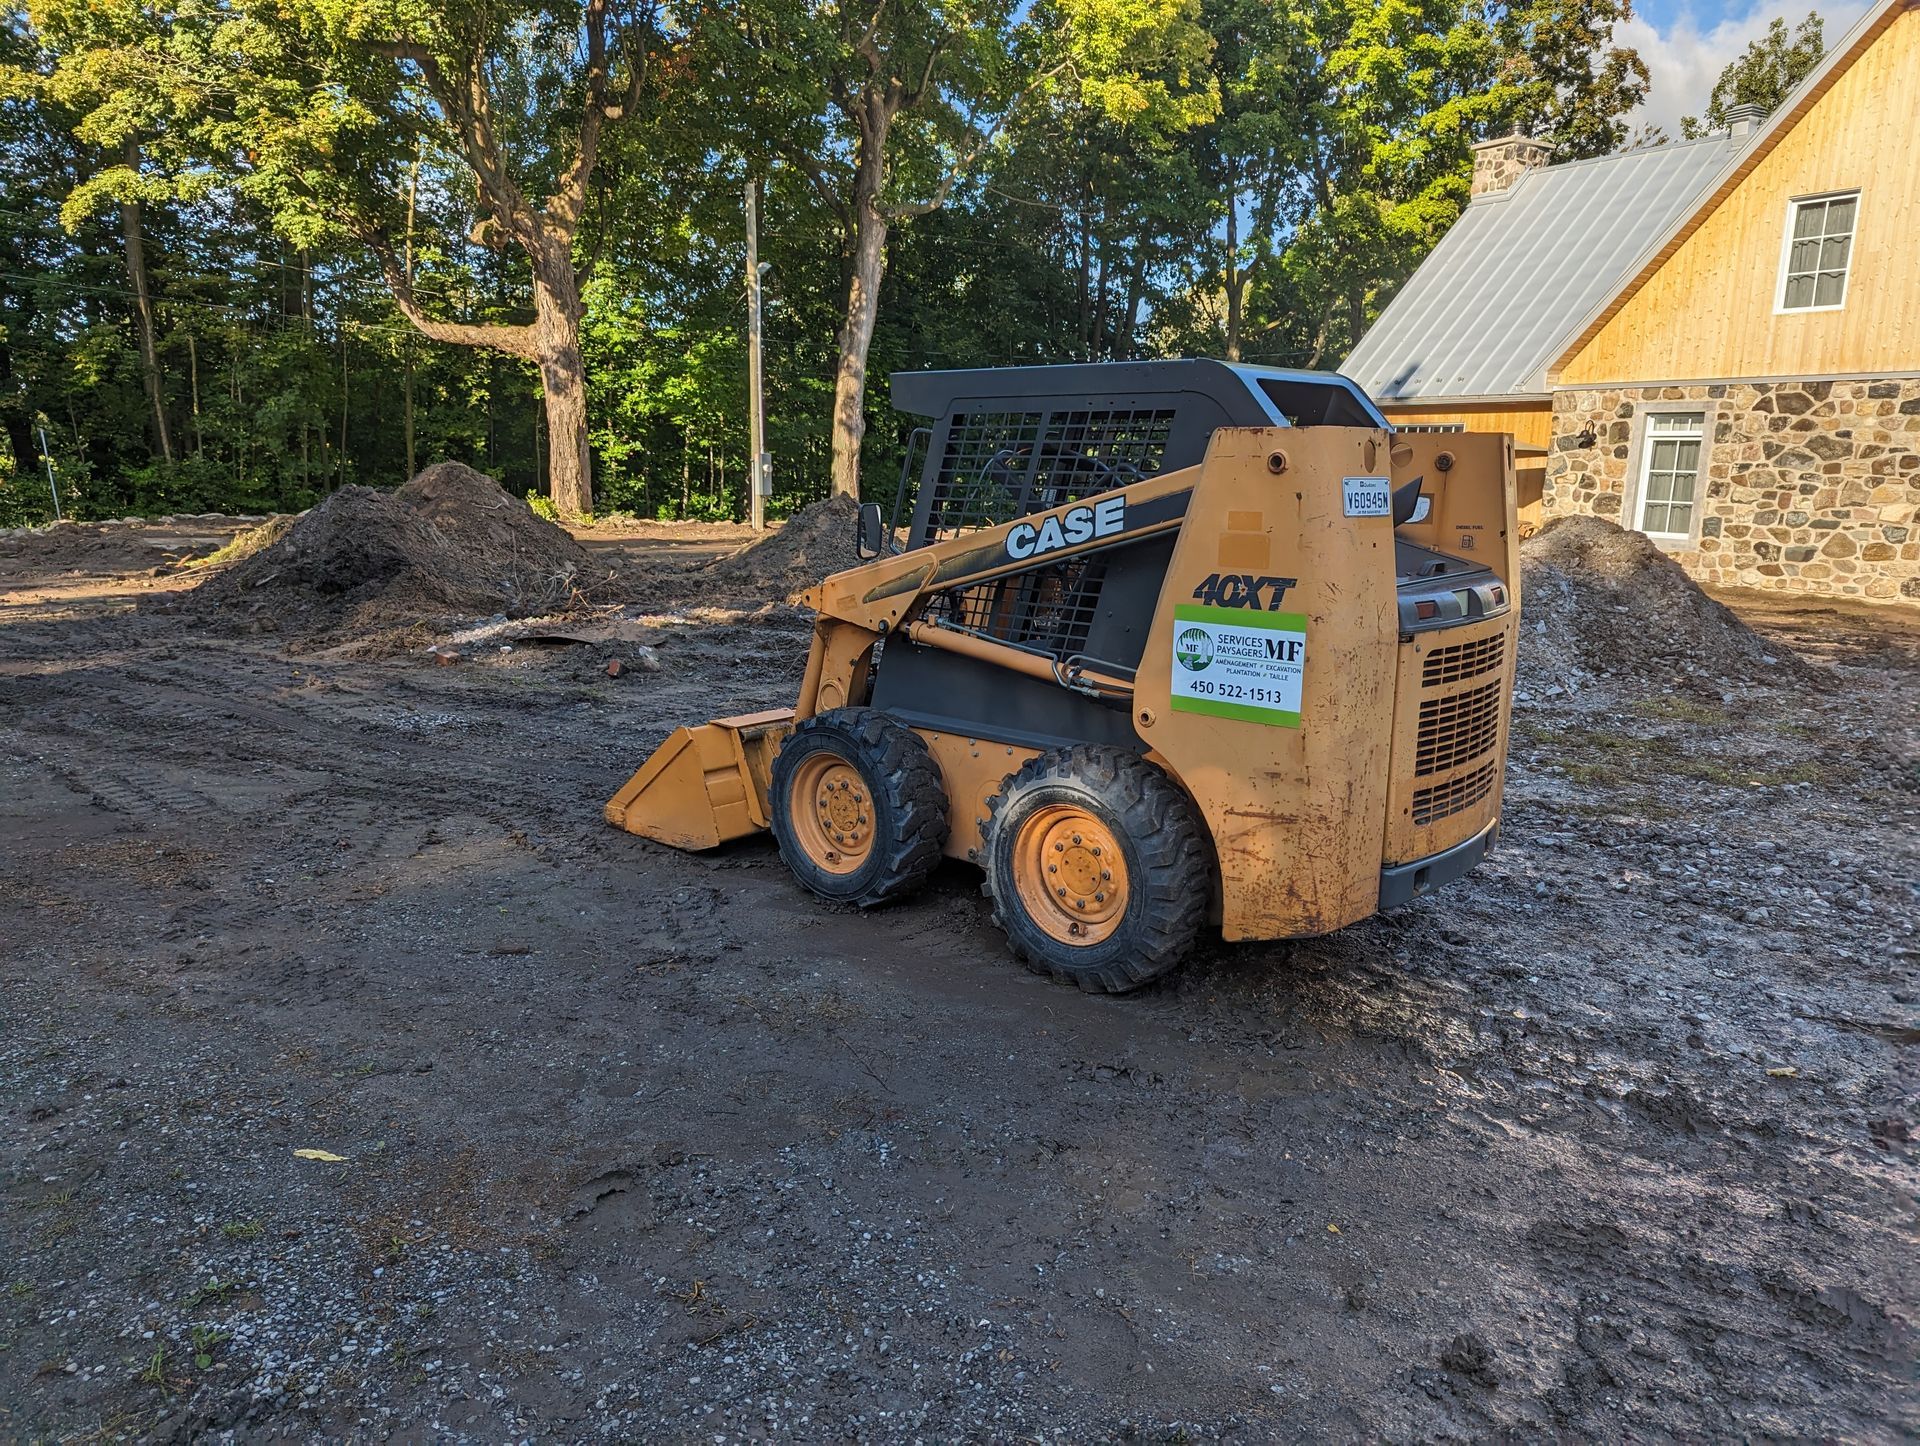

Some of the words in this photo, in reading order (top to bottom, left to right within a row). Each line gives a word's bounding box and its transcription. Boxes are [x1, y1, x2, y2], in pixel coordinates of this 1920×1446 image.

[1347, 492, 1388, 509] V60945N
[1006, 494, 1126, 559] CASE
[1192, 573, 1298, 611] 40XT
[1185, 643, 1199, 653] MF
[1218, 634, 1263, 648] SERVICES
[1216, 645, 1263, 659] PAYSAGERS
[1264, 638, 1303, 662] MF
[1215, 658, 1258, 669] AMÉNAGEMENT
[1265, 664, 1302, 674] EXCAVATION
[1226, 668, 1261, 678] PLANTATION
[1269, 673, 1289, 681] TAILLE
[1190, 680, 1214, 694] 450
[1218, 683, 1282, 704] 522-1513
